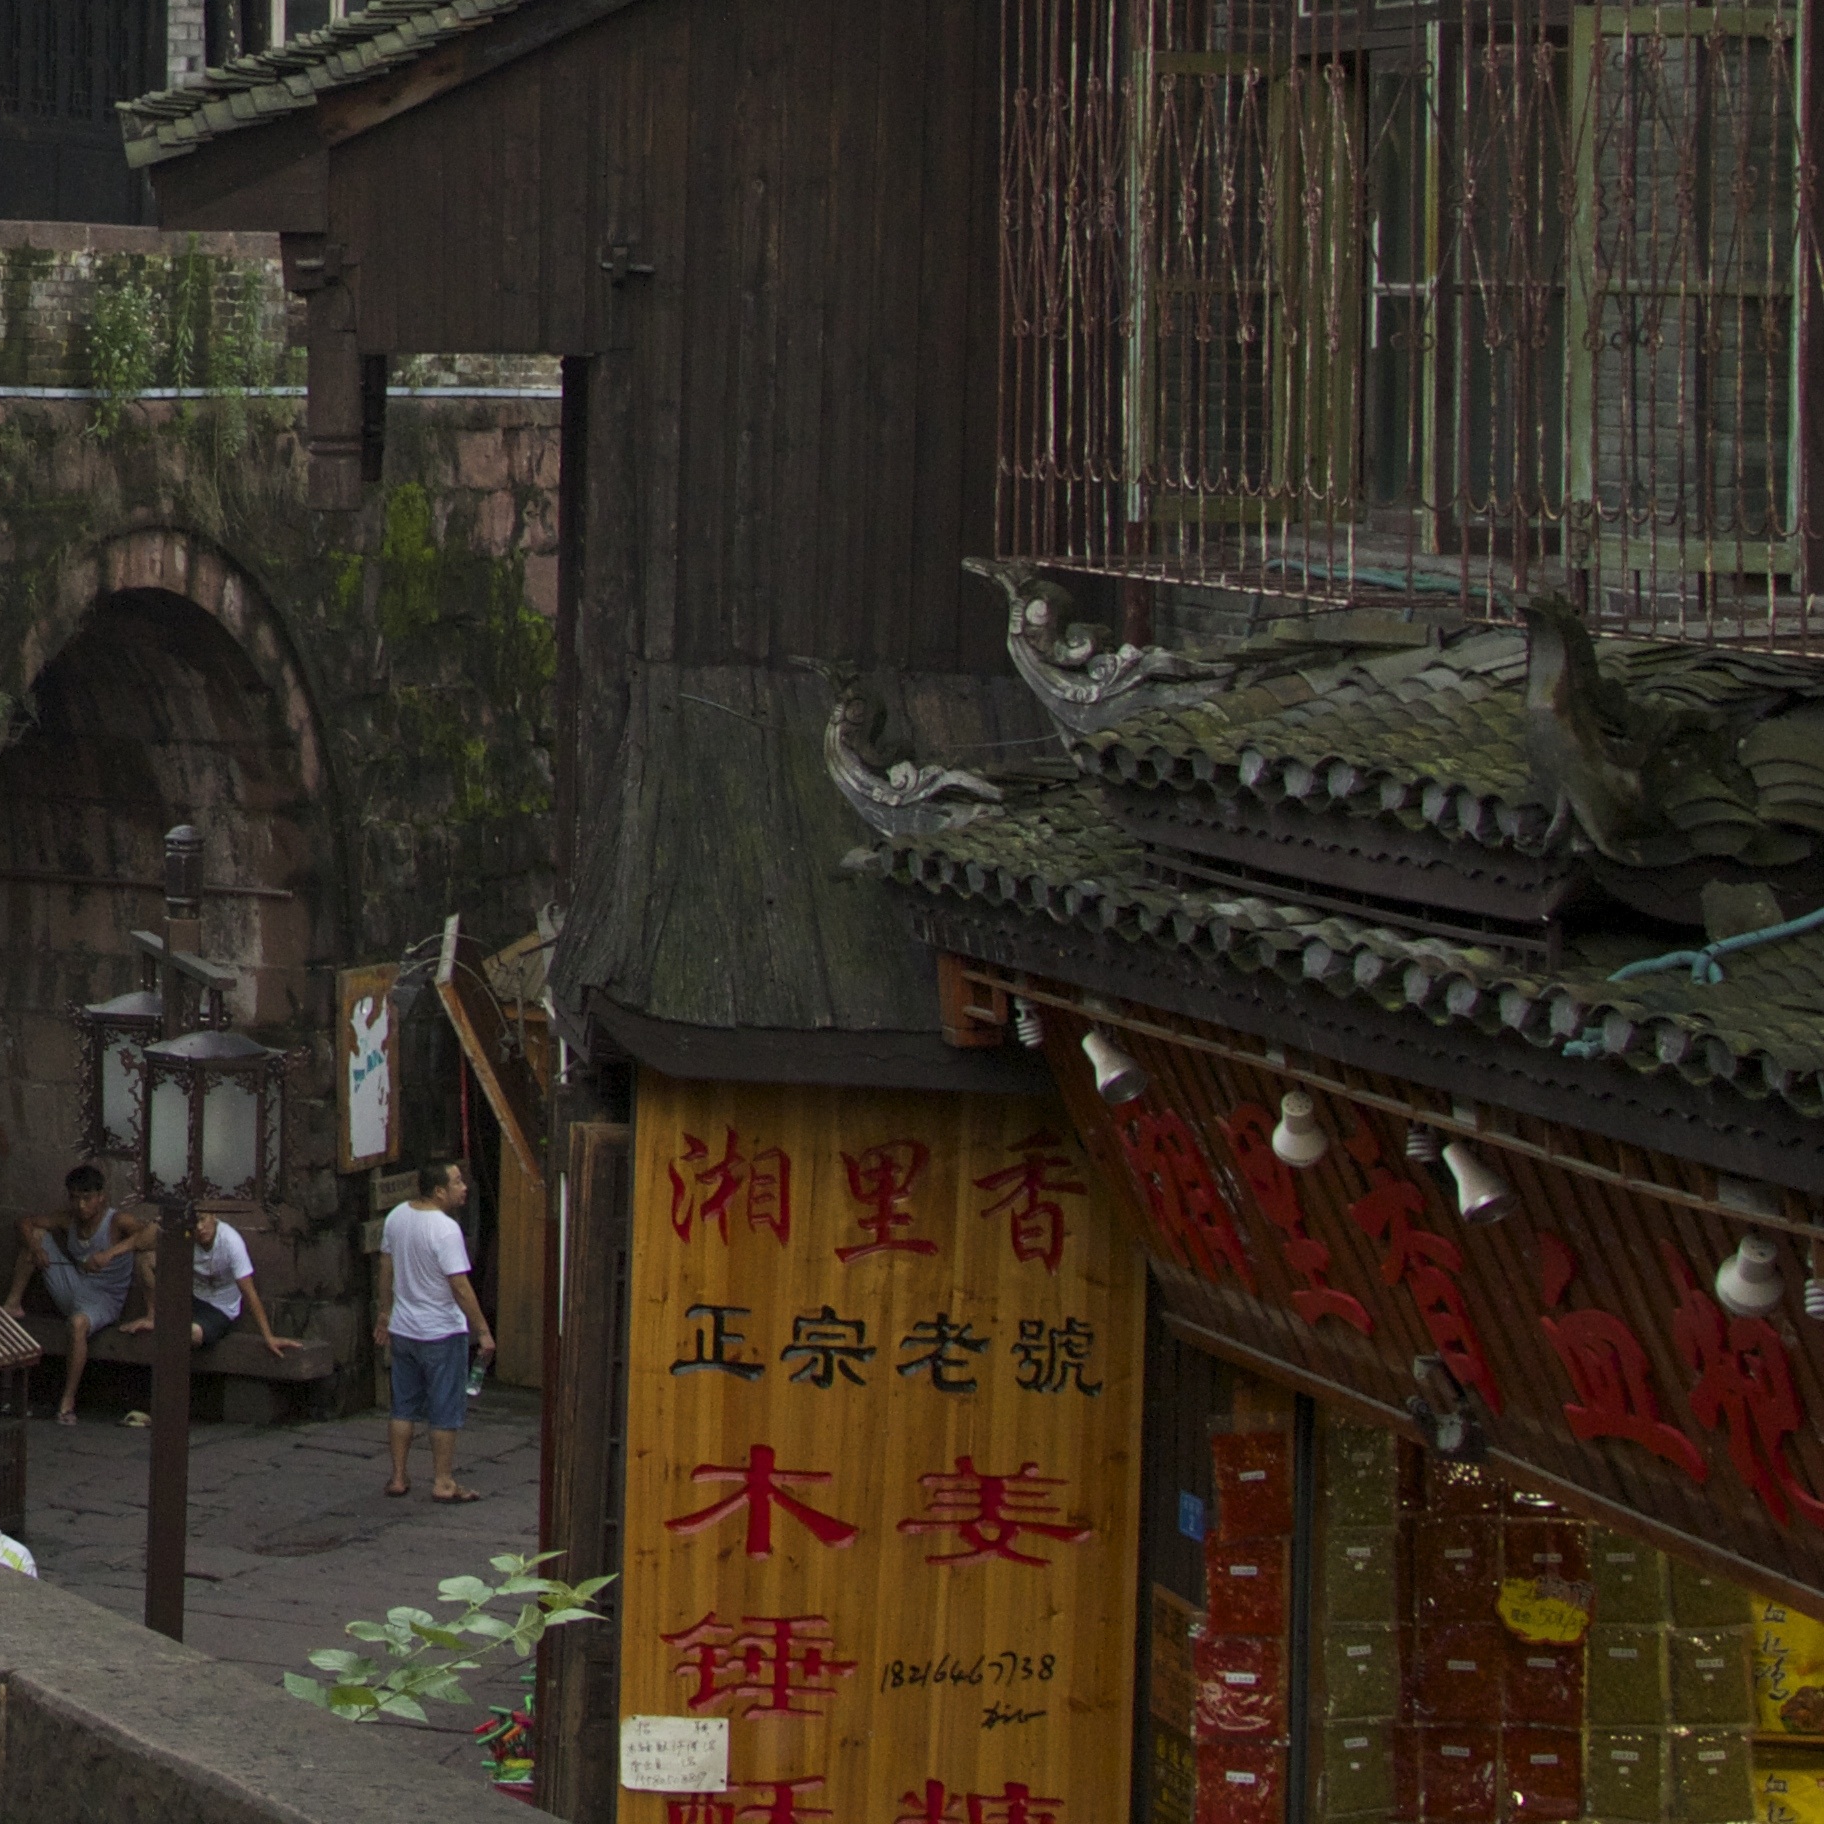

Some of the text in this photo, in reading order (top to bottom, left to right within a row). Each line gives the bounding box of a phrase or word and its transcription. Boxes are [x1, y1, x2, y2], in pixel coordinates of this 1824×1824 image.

[666, 1122, 1090, 1278] 湘里香
[669, 1301, 1104, 1398] 正宗老號
[879, 1650, 1057, 1695] 18216467738
